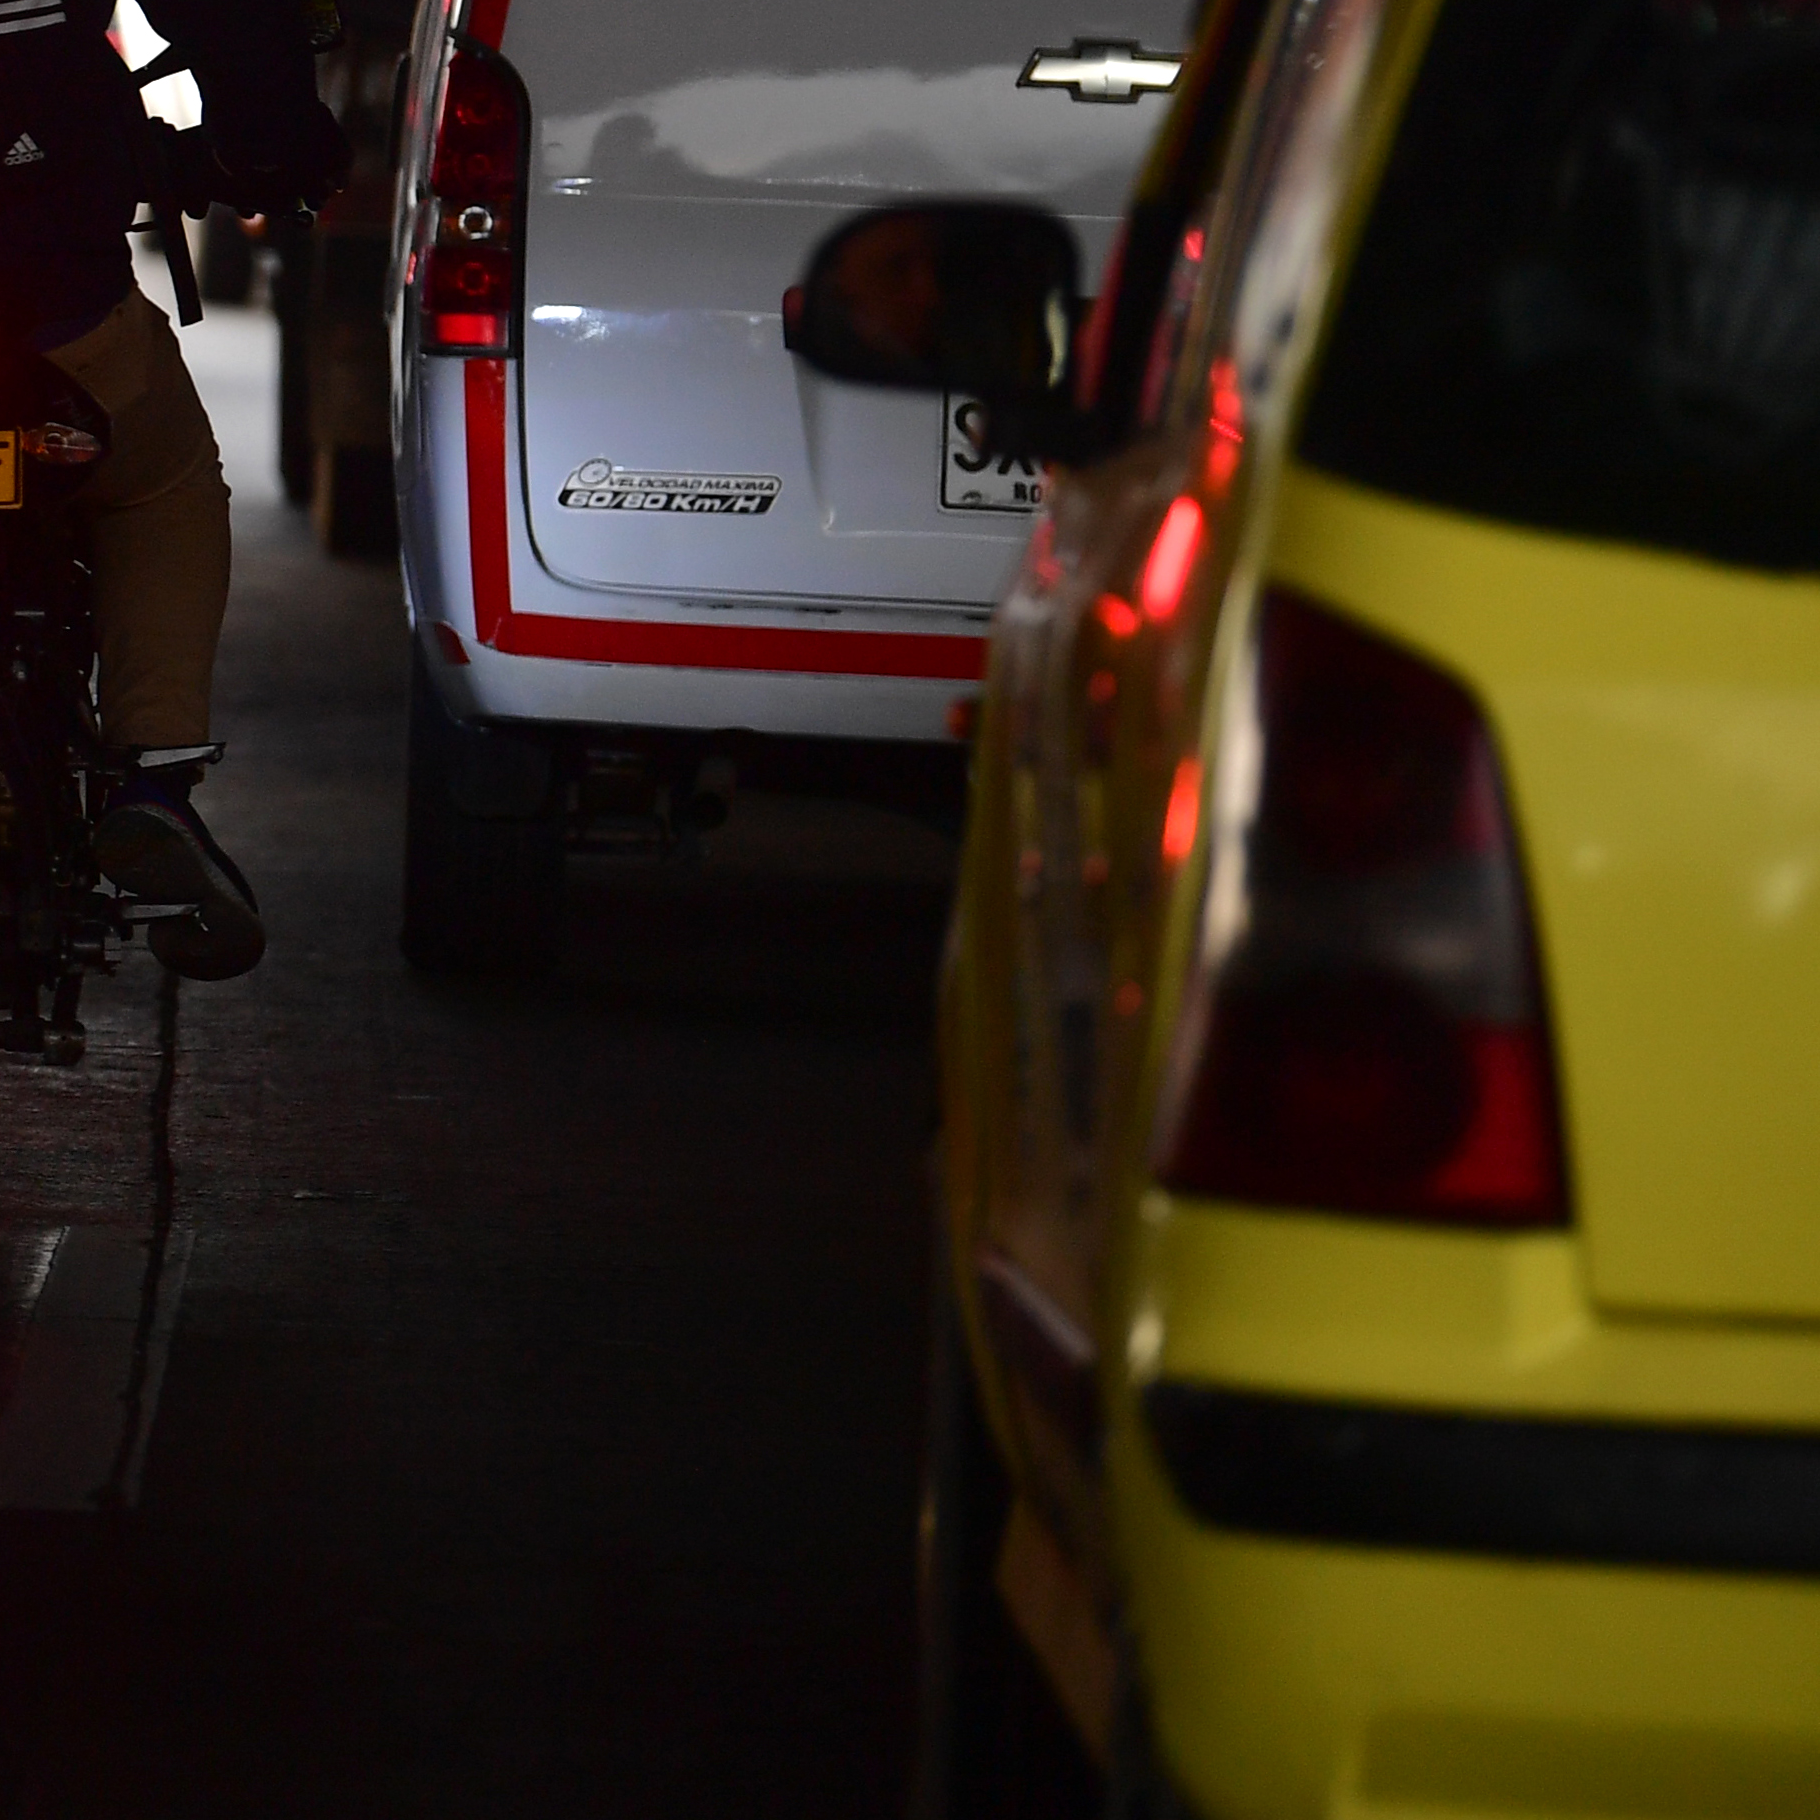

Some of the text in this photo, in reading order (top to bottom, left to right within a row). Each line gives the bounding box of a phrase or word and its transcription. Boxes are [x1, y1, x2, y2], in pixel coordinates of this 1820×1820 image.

[609, 478, 775, 492] VELOCIDAD MAXIMA
[566, 491, 761, 513] 60/80 Km/H
